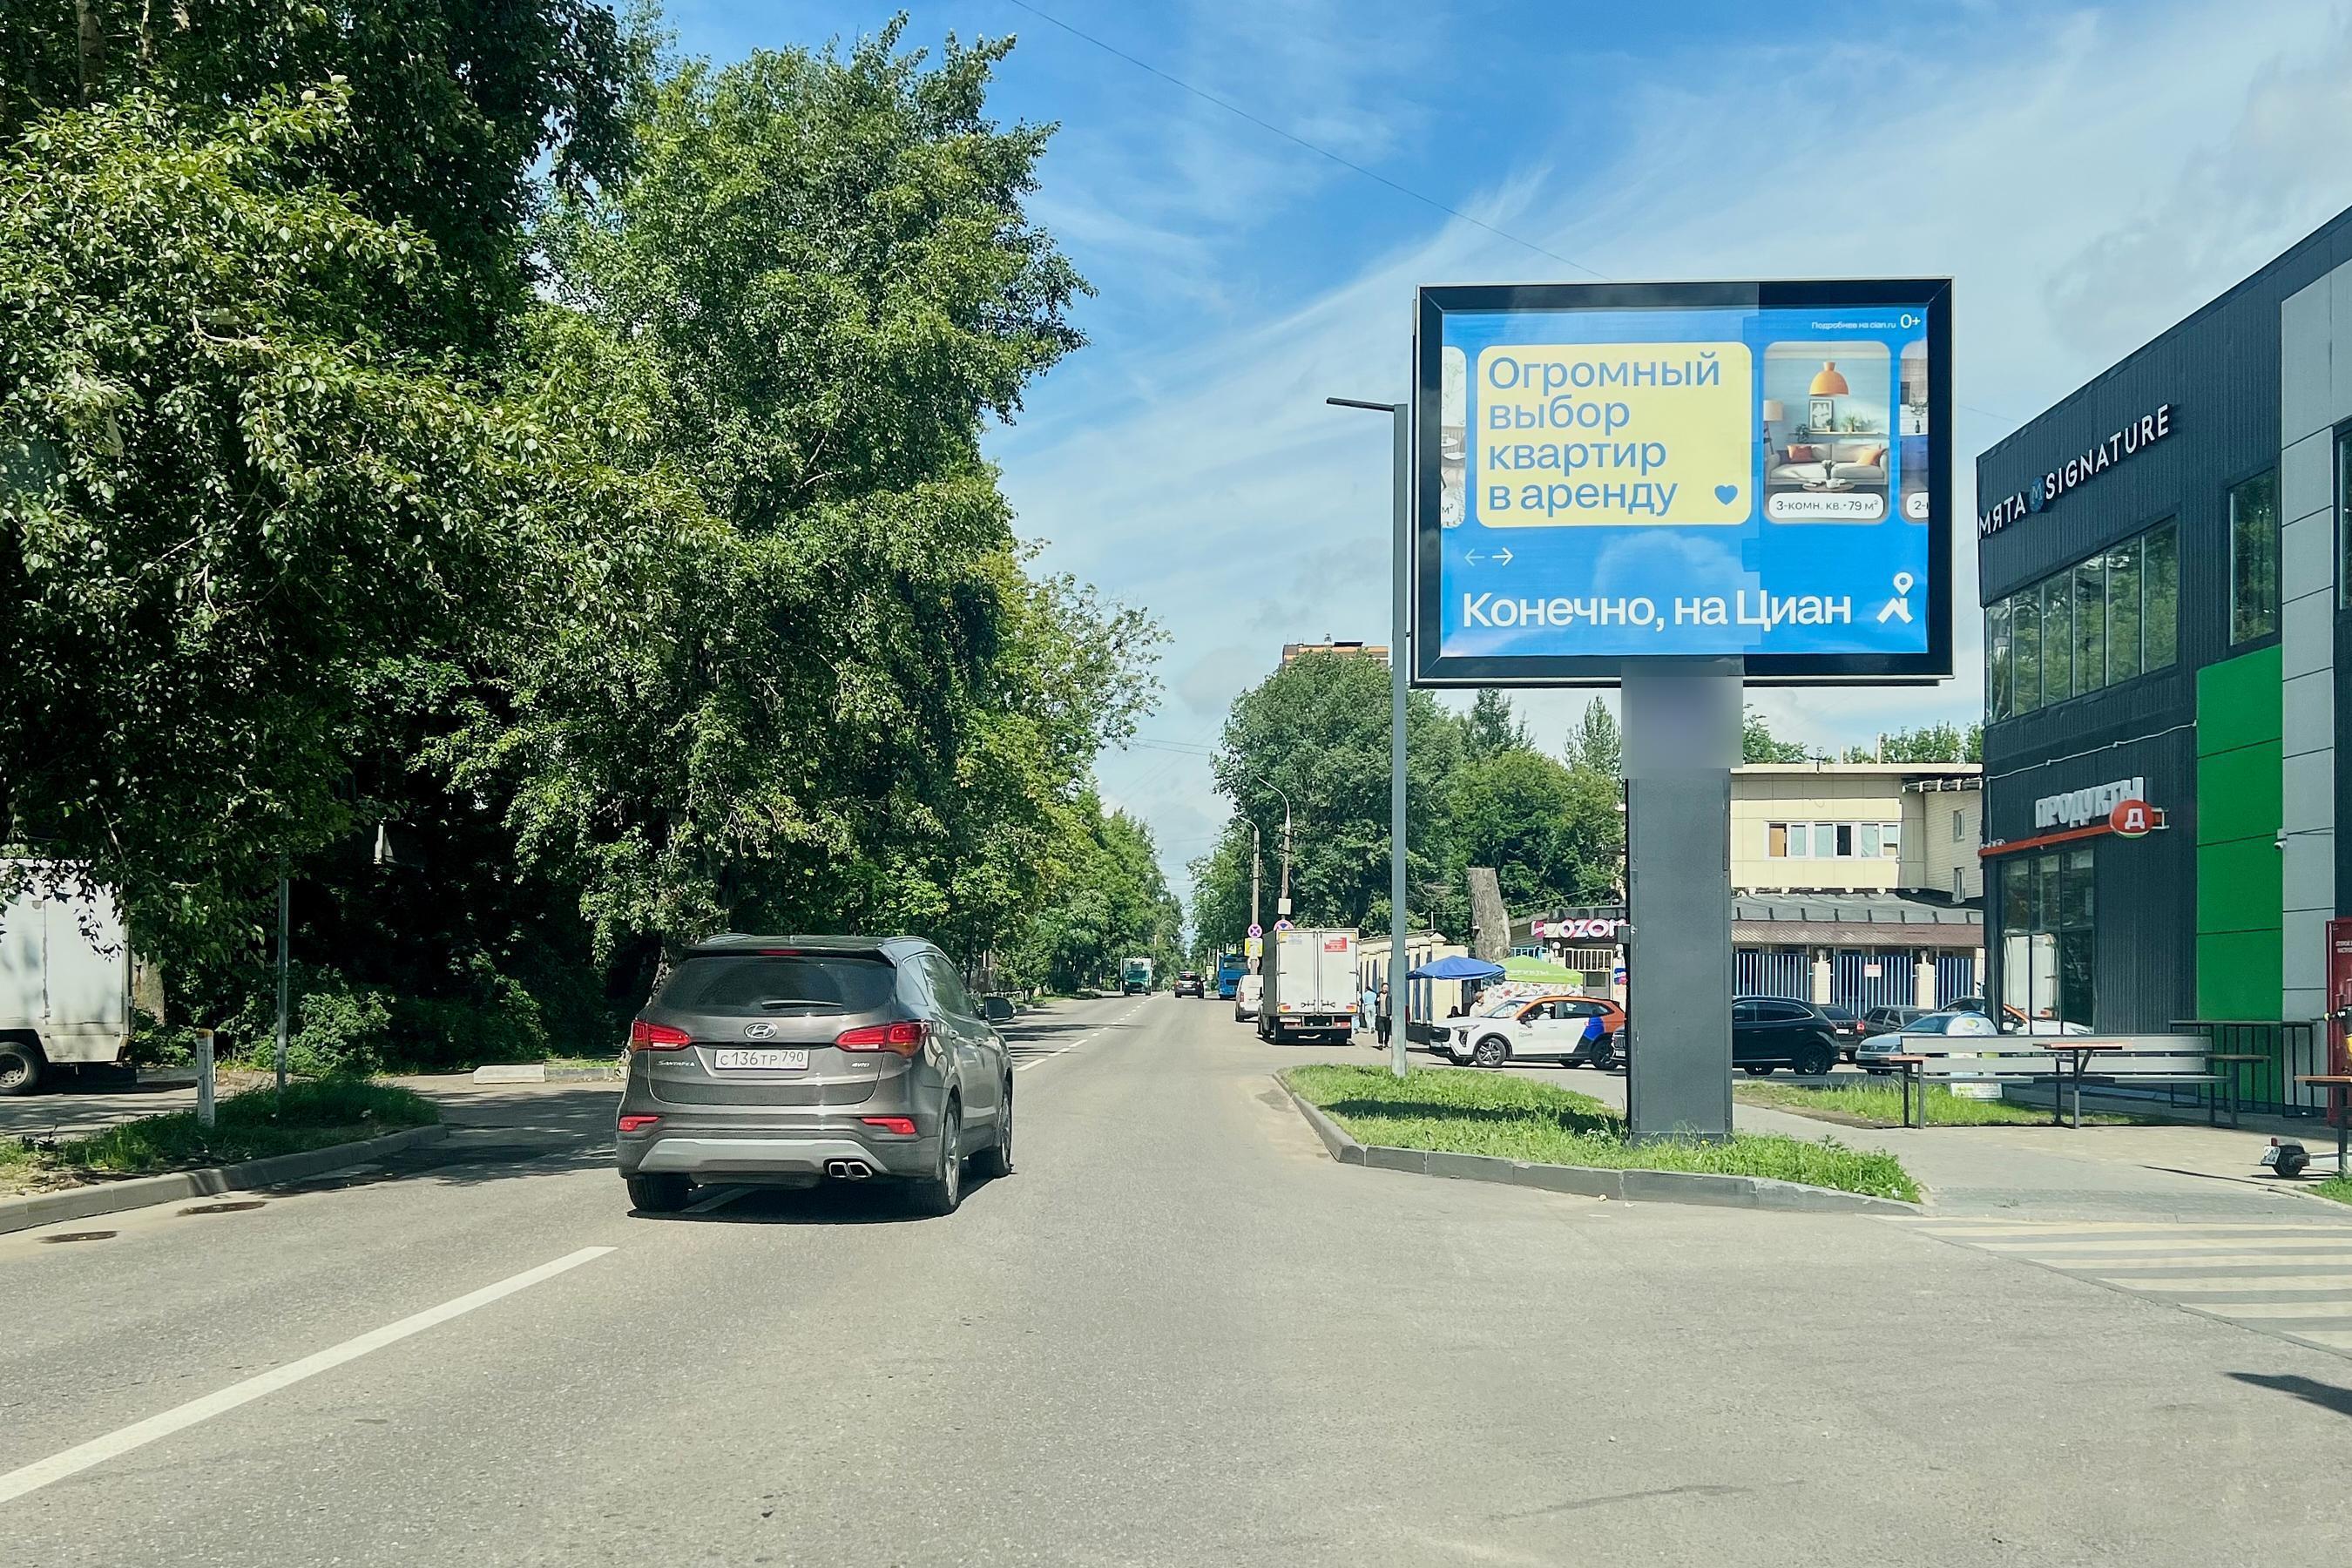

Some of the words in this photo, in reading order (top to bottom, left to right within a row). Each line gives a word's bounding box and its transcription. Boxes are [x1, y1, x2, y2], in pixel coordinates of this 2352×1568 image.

[1812, 321, 1857, 330] Подробнее
[1900, 314, 1921, 329] 0+
[1489, 351, 1720, 396] Огромный
[1489, 395, 1630, 436] выбор
[1489, 442, 1666, 476] квартир
[1978, 491, 2026, 540] МЯТА
[2045, 403, 2169, 500] SIGNATURE
[1489, 485, 1511, 510] в
[1520, 483, 1678, 517] аренду
[1776, 500, 1823, 510] 3-комн.
[1463, 592, 1666, 632] Конечно,
[1674, 596, 1728, 626] на
[1736, 589, 1852, 632] Циан
[2124, 808, 2146, 830] Д
